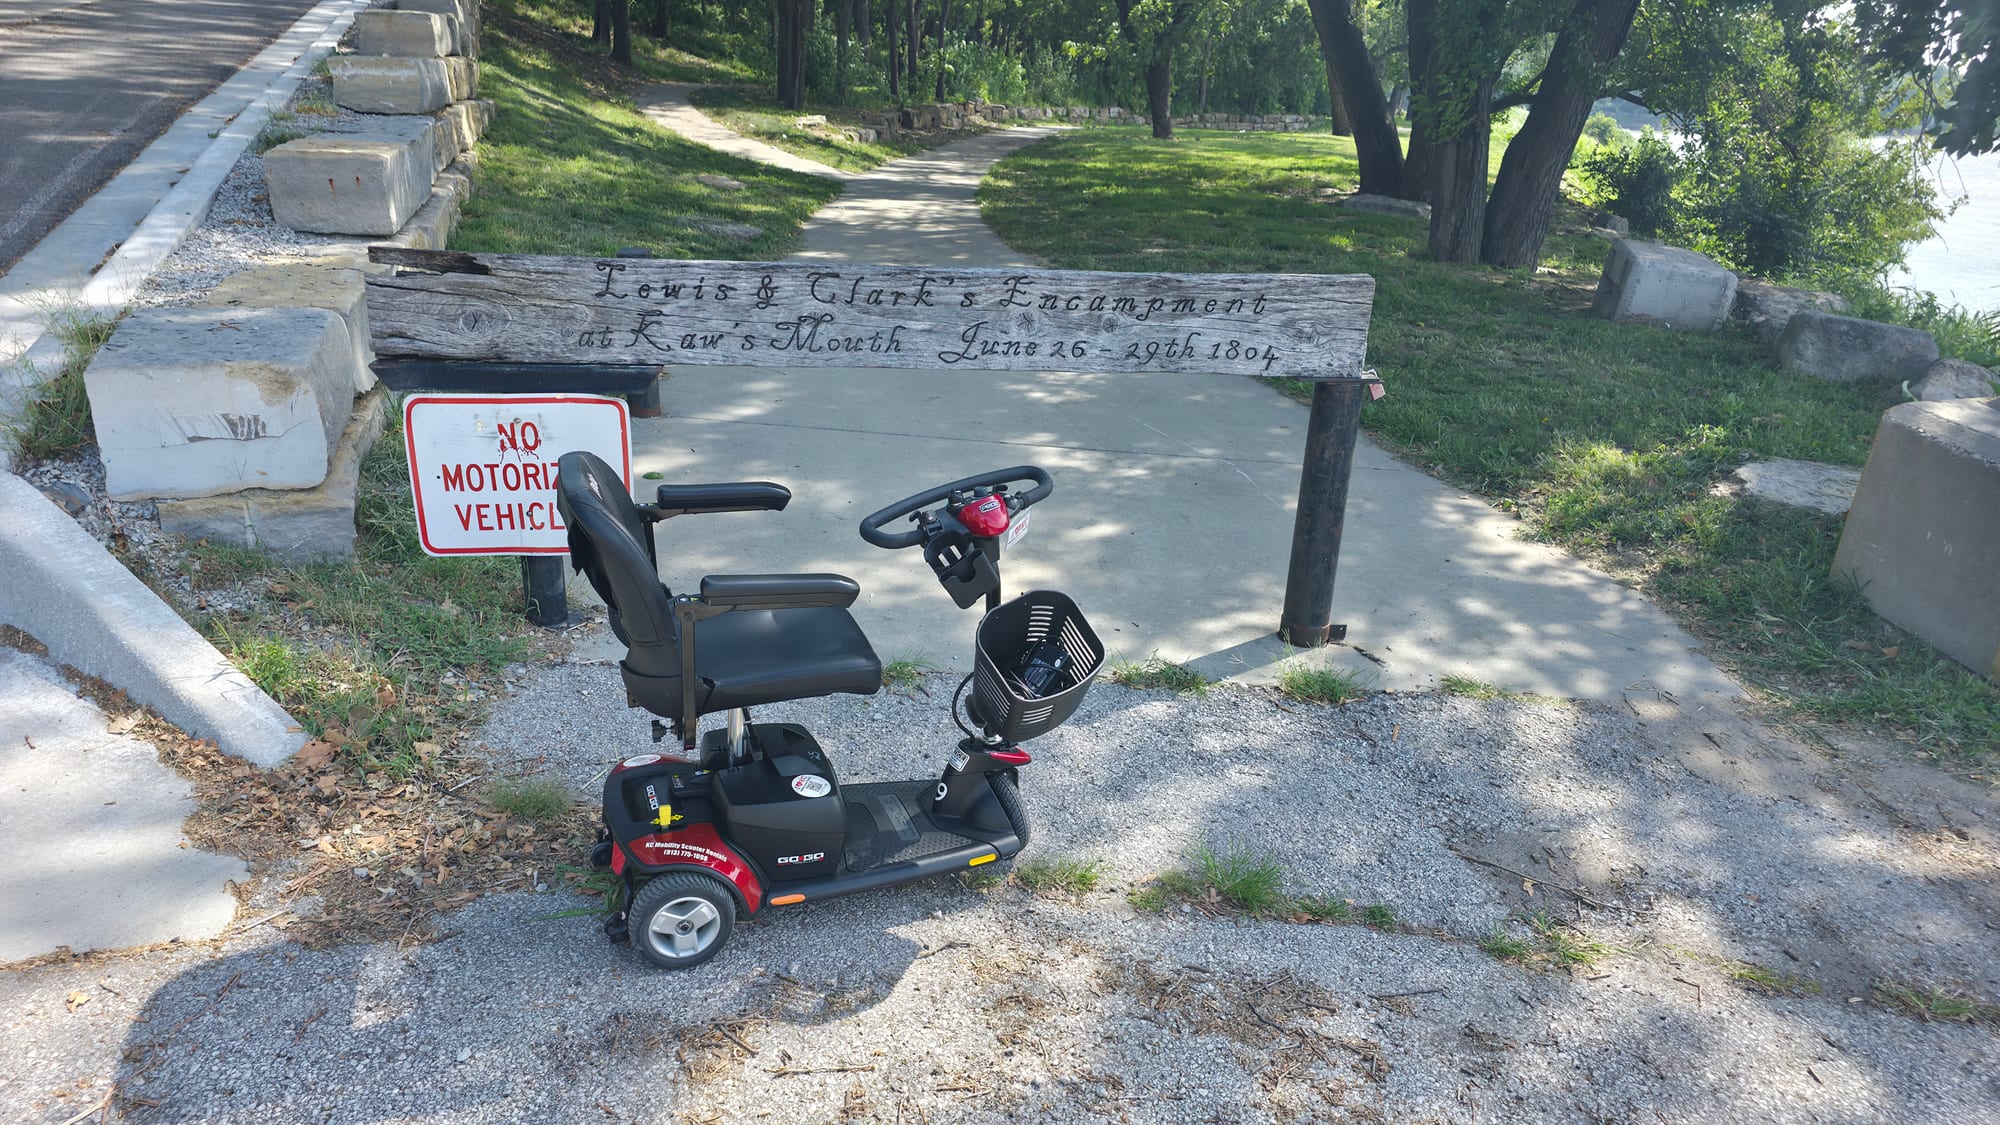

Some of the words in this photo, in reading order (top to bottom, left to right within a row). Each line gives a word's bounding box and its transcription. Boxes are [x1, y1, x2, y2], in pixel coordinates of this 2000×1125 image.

[595, 261, 738, 301] Lewis
[756, 274, 779, 310] &
[806, 271, 976, 308] Clark's
[999, 275, 1268, 322] Encampment
[578, 326, 614, 349] at
[625, 309, 757, 352] Kaw's
[770, 313, 907, 354] Mouth
[938, 321, 1038, 364] June
[1050, 340, 1087, 359] 26
[1125, 331, 1202, 366] 29th
[1207, 339, 1280, 371] 1804
[497, 421, 542, 452] NO
[441, 463, 559, 491] MOTORIZ
[454, 502, 566, 531] VEHICL
[935, 782, 948, 801] 9
[655, 841, 681, 850] Mobility
[681, 843, 706, 853] Scooter
